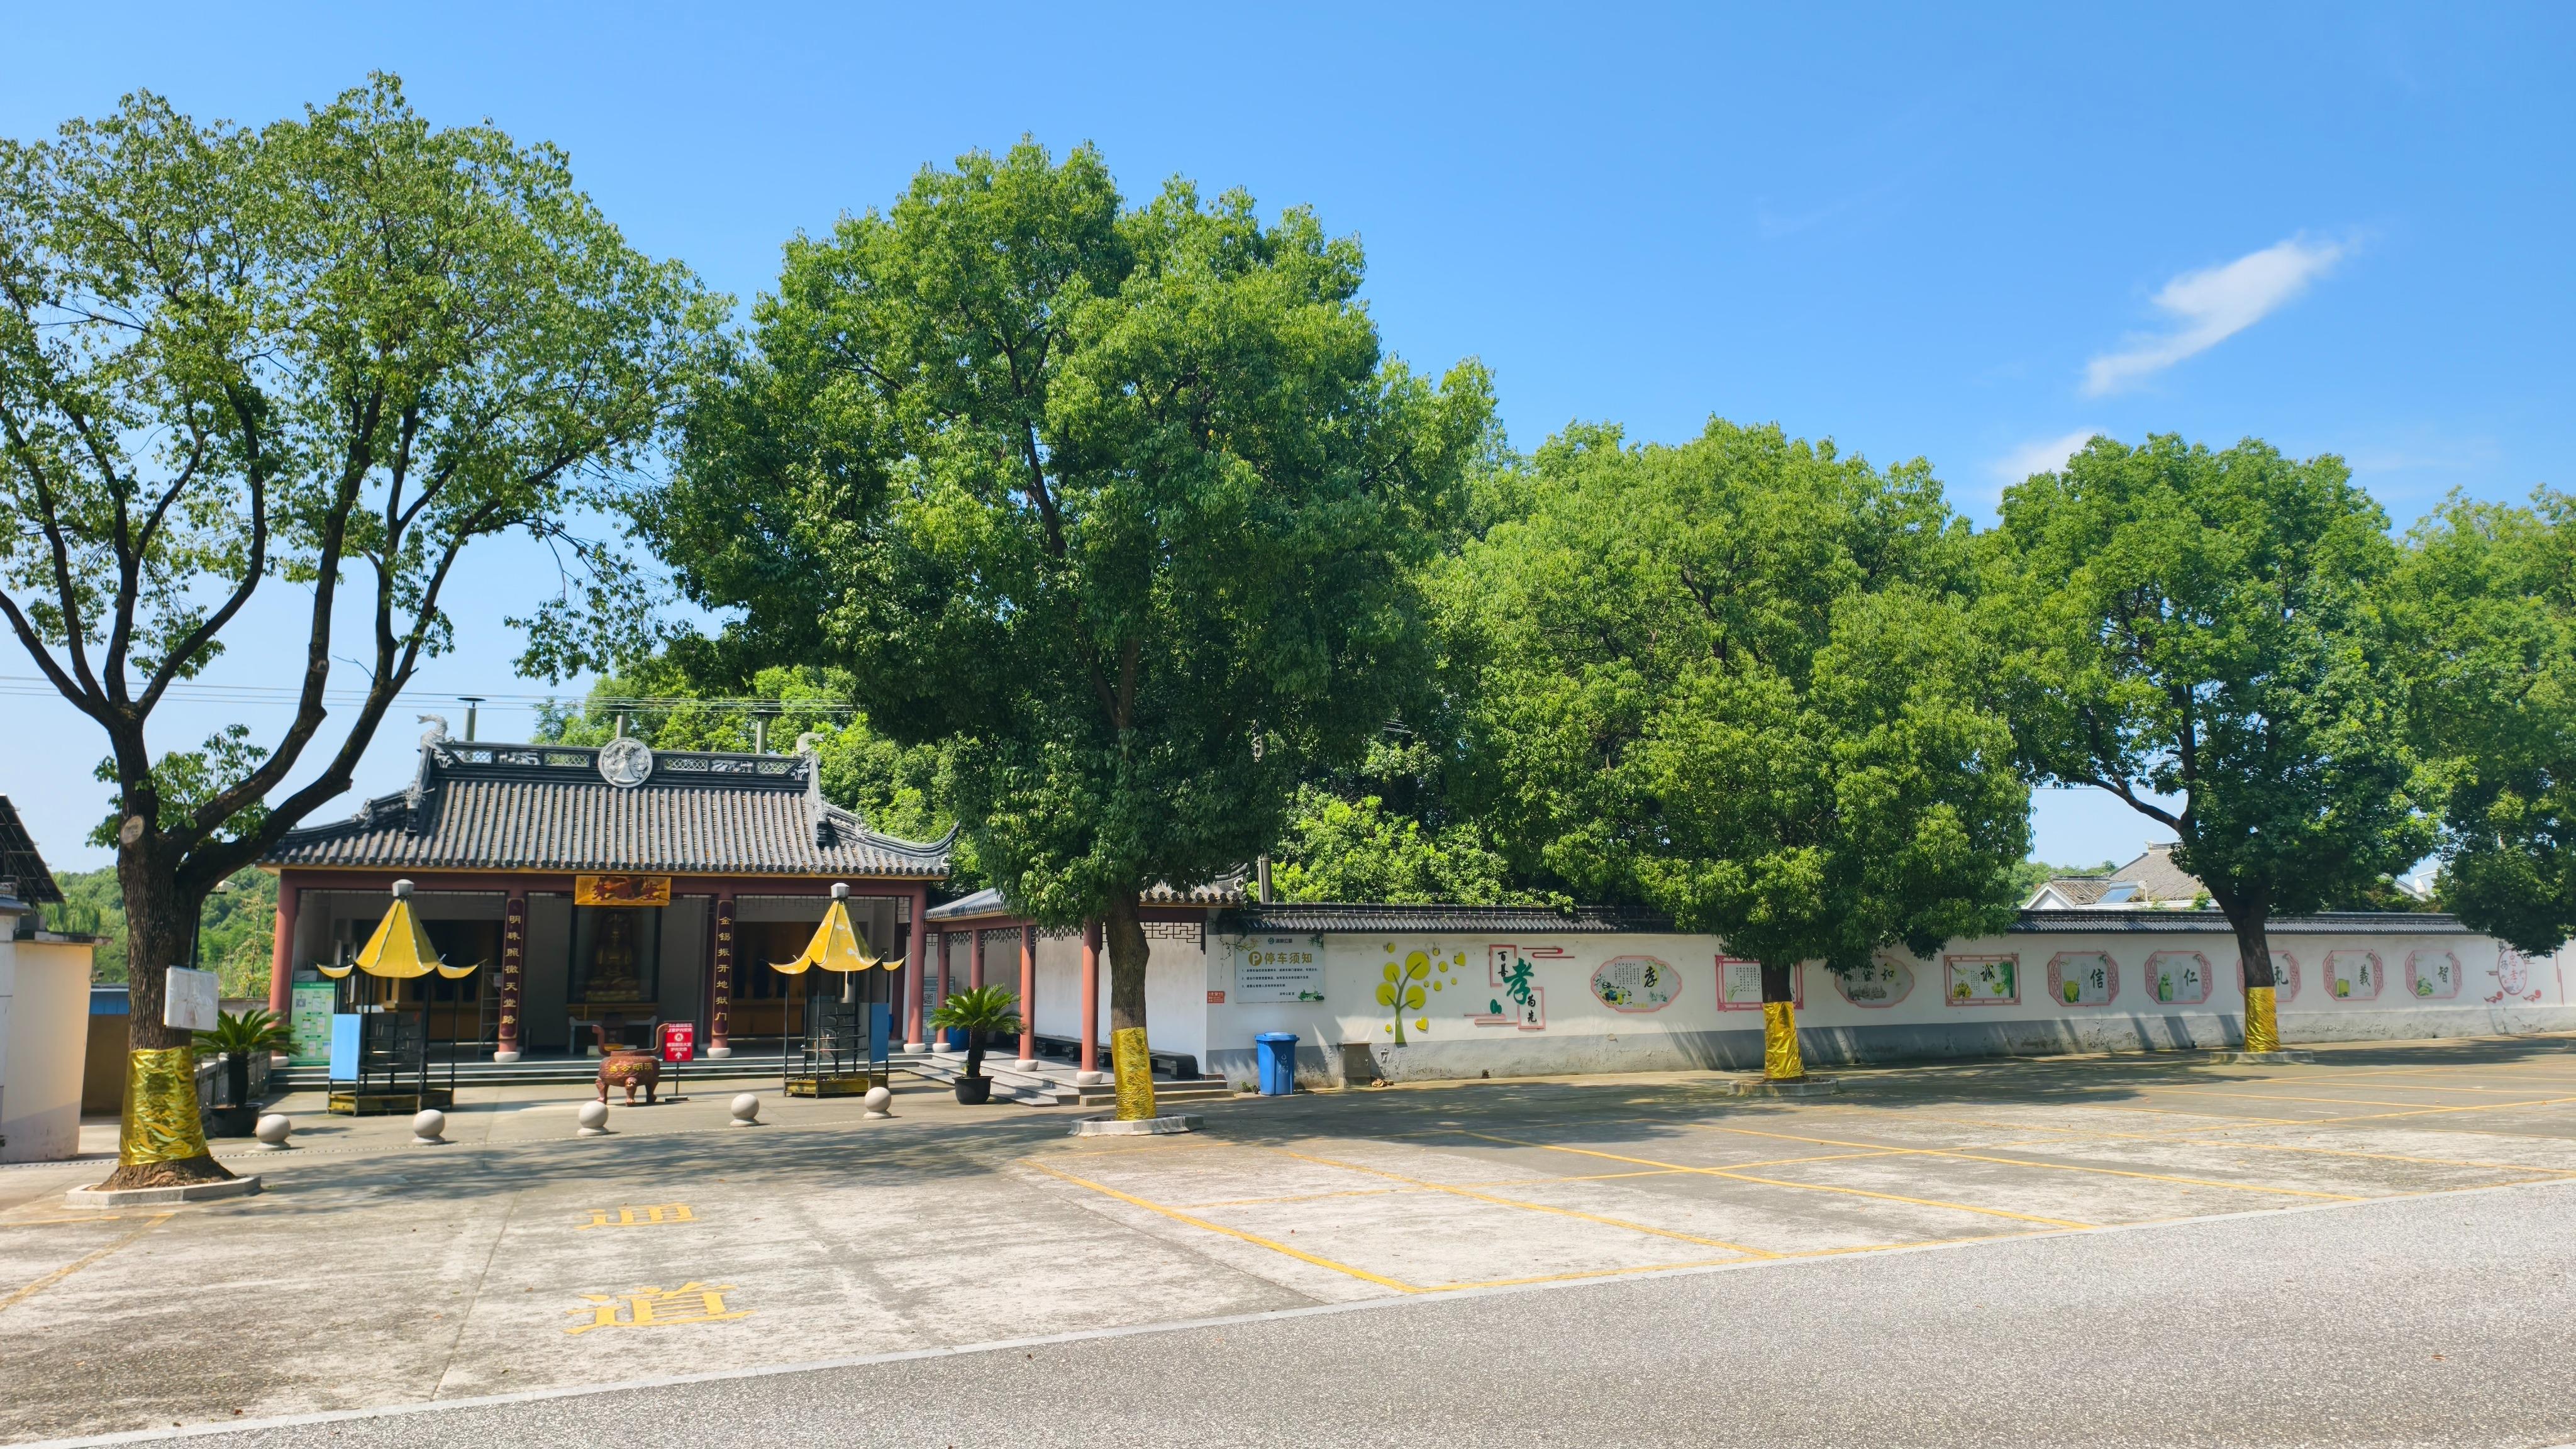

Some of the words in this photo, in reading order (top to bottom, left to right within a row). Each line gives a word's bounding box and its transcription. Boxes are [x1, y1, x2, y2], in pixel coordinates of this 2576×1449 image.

[1265, 952, 1313, 965] 停车须知
[1497, 951, 1508, 977] 百善
[1503, 957, 1534, 1004] 孝
[1644, 966, 1657, 987] 孝
[2090, 969, 2104, 989] 信
[2184, 969, 2198, 986] 仁
[2438, 966, 2448, 984] 智
